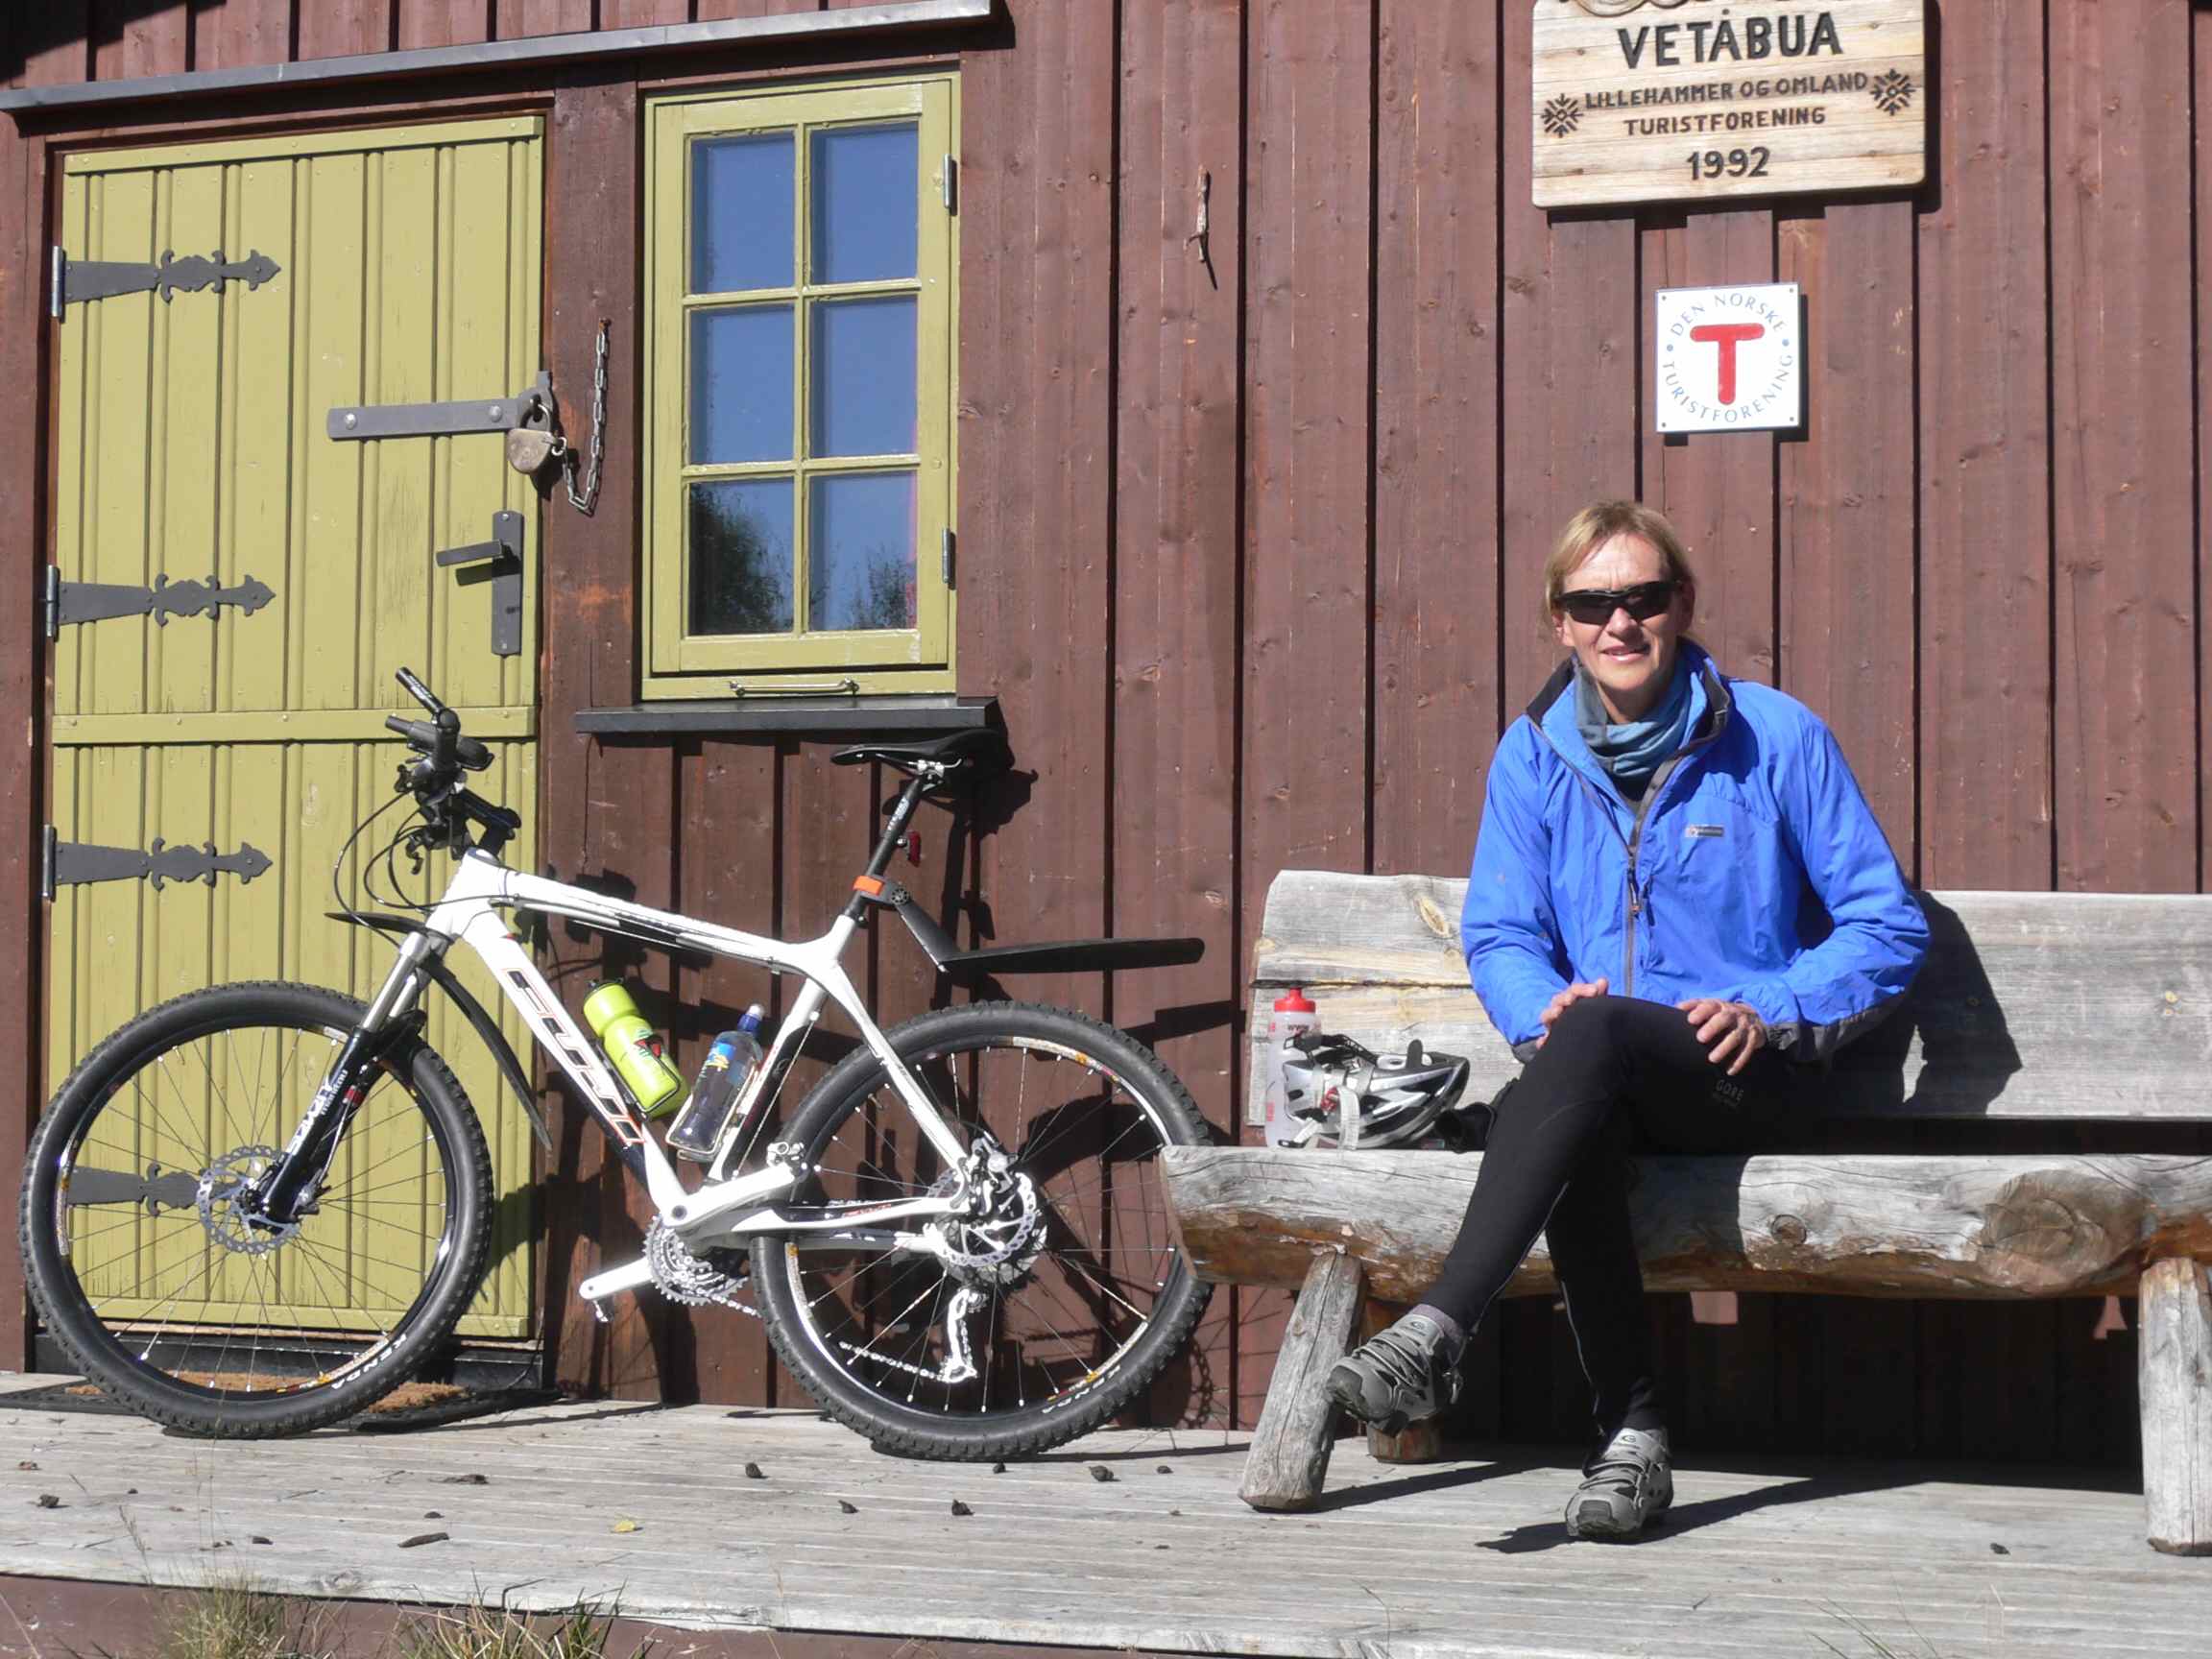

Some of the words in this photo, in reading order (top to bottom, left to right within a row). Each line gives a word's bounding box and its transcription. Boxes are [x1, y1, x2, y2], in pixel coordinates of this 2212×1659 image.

[1617, 9, 1843, 69] VETÅBUA
[1585, 82, 1733, 109] LILLEHAMMER
[1740, 80, 1770, 97] OG
[1775, 72, 1868, 94] OMLAND
[1623, 107, 1826, 136] TURISTFORENING
[1687, 146, 1771, 180] 1992
[1670, 301, 1706, 337] DEN
[1714, 293, 1786, 333] NORSKE
[1662, 354, 1793, 423] TURISTFORENING
[1689, 323, 1766, 406] T
[501, 968, 648, 1144] FUJI
[330, 1333, 408, 1390] KENDA
